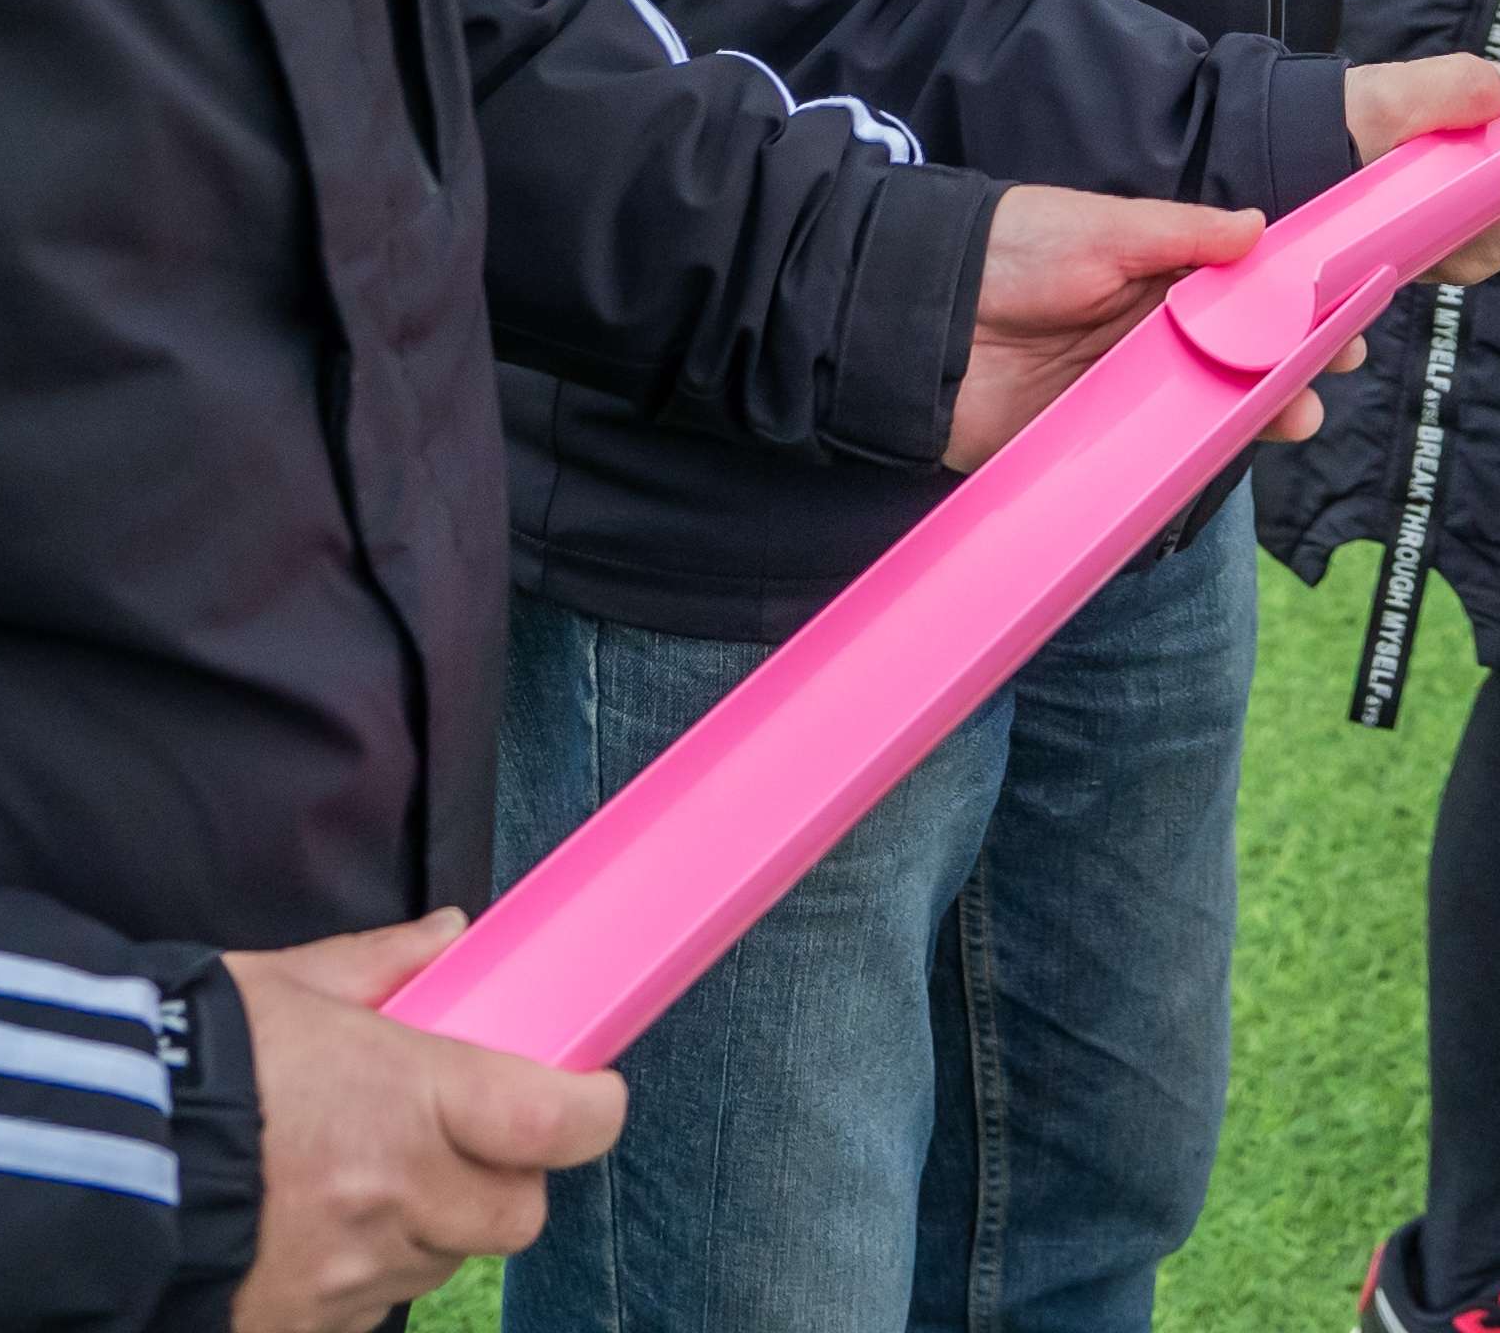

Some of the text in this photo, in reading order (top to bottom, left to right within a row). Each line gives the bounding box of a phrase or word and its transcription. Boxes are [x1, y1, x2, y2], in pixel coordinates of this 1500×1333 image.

[1425, 307, 1461, 394] MYSELF
[1407, 425, 1444, 503] BREAK
[1384, 503, 1431, 609] THROUGH
[1367, 609, 1408, 699] MYSELF
